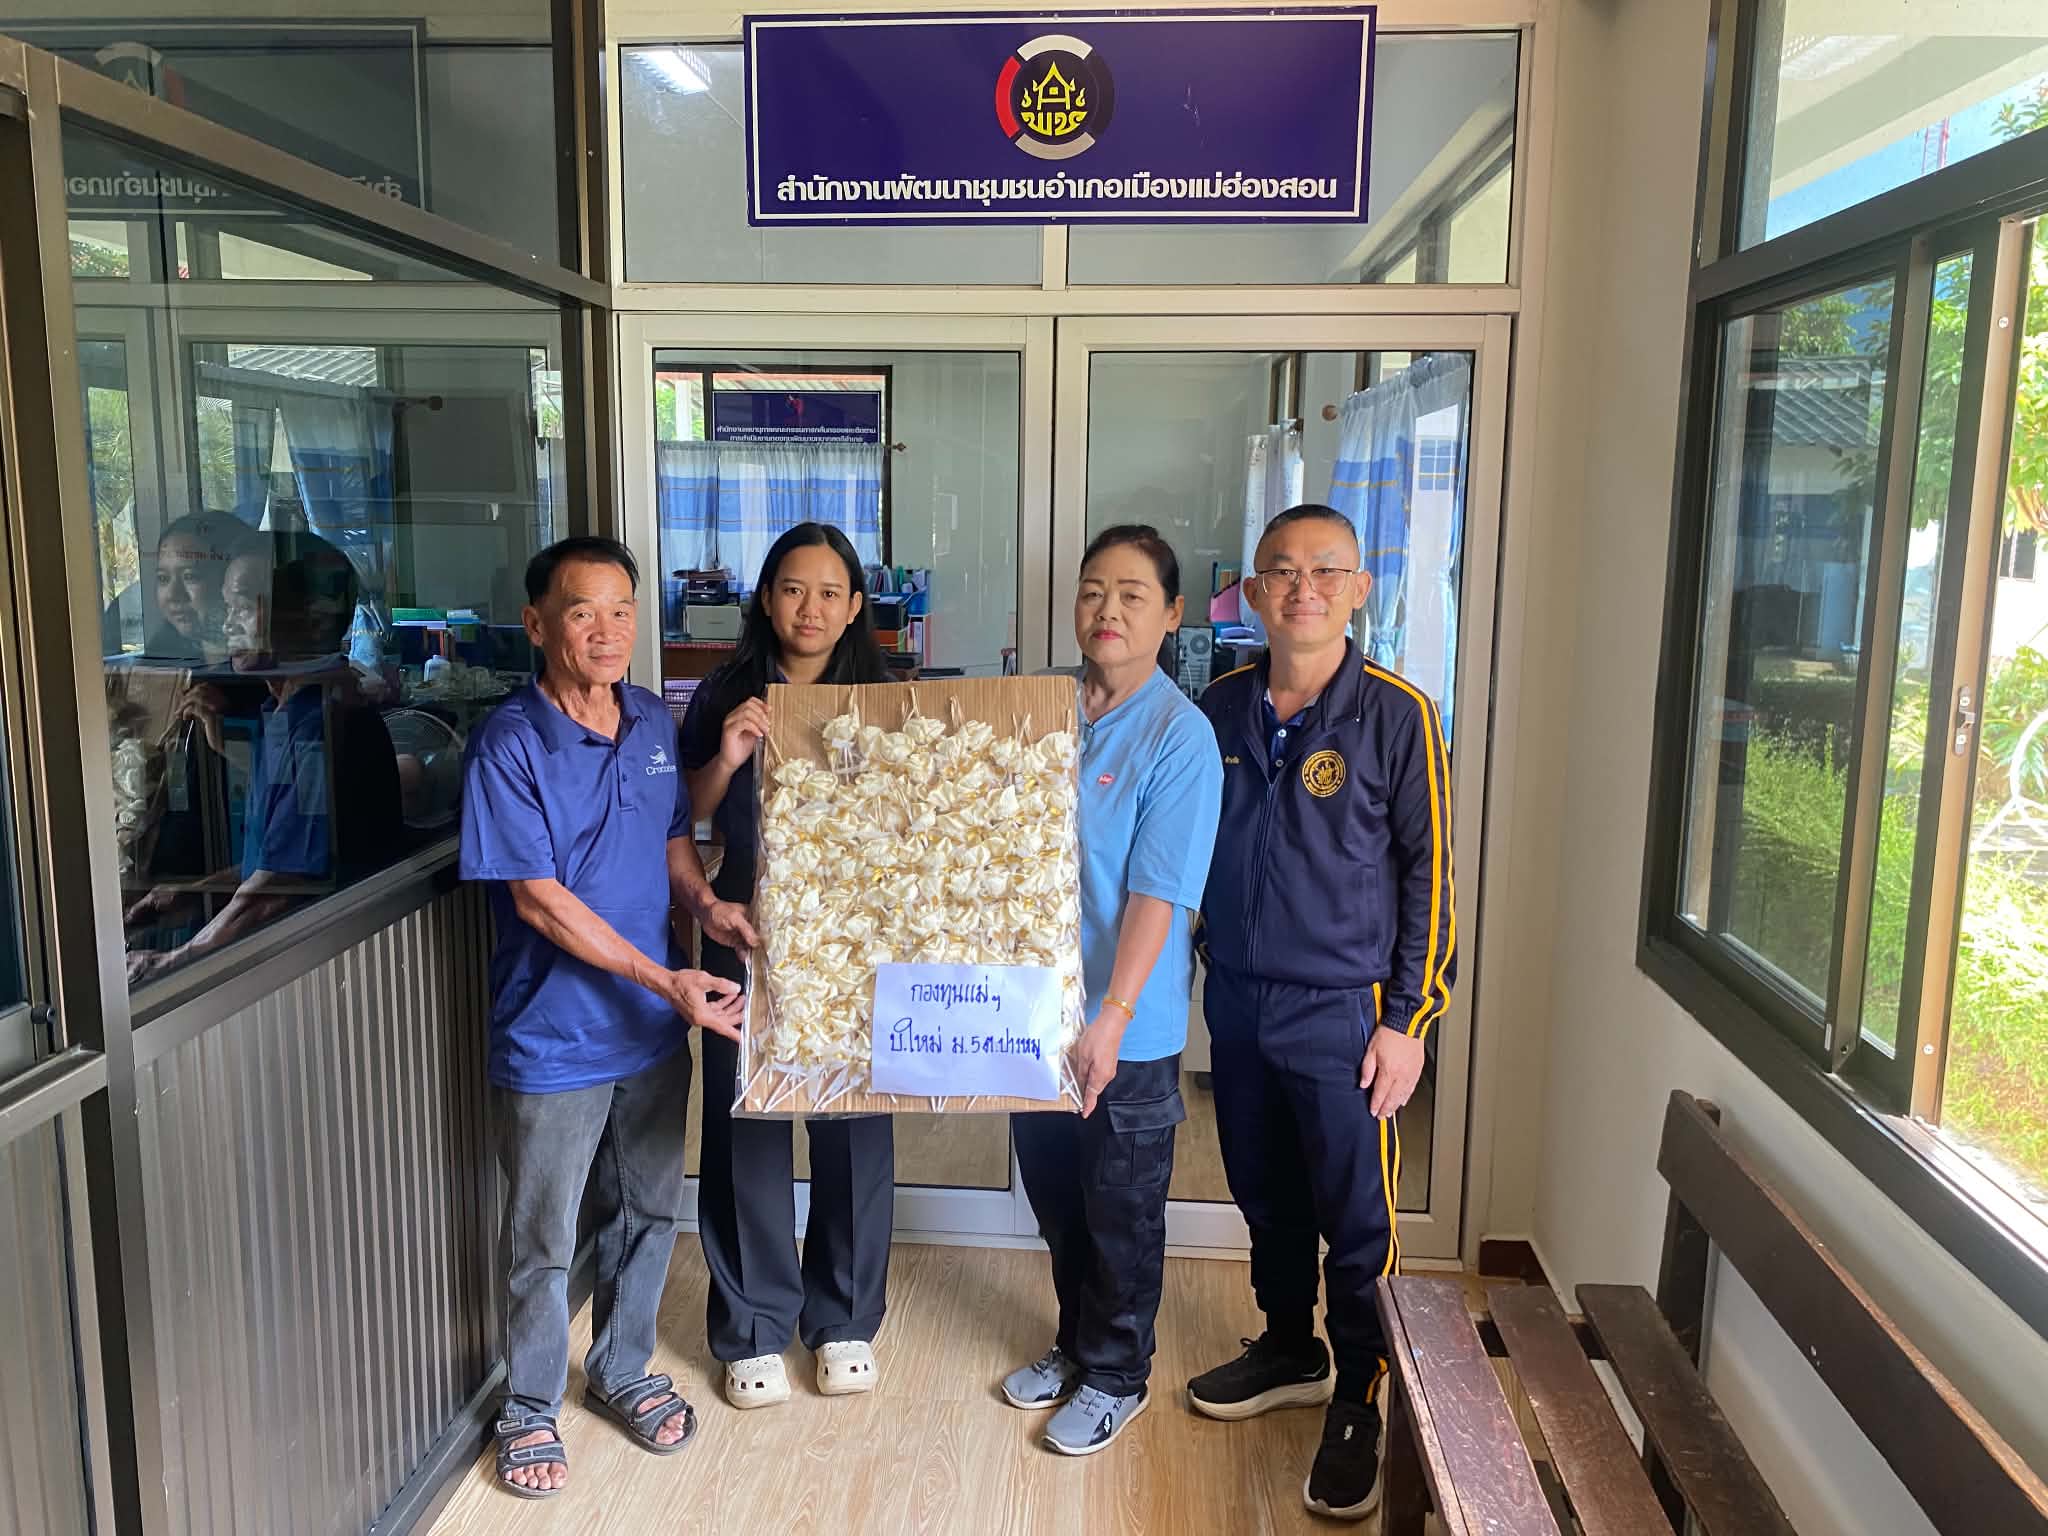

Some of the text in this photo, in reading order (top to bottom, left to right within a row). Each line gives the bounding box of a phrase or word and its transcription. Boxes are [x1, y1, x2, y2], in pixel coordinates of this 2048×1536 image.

[776, 172, 1338, 207] สำนักงานพัฒนาชุมชนอำเภอเมืองแม่ฮ่องสอน
